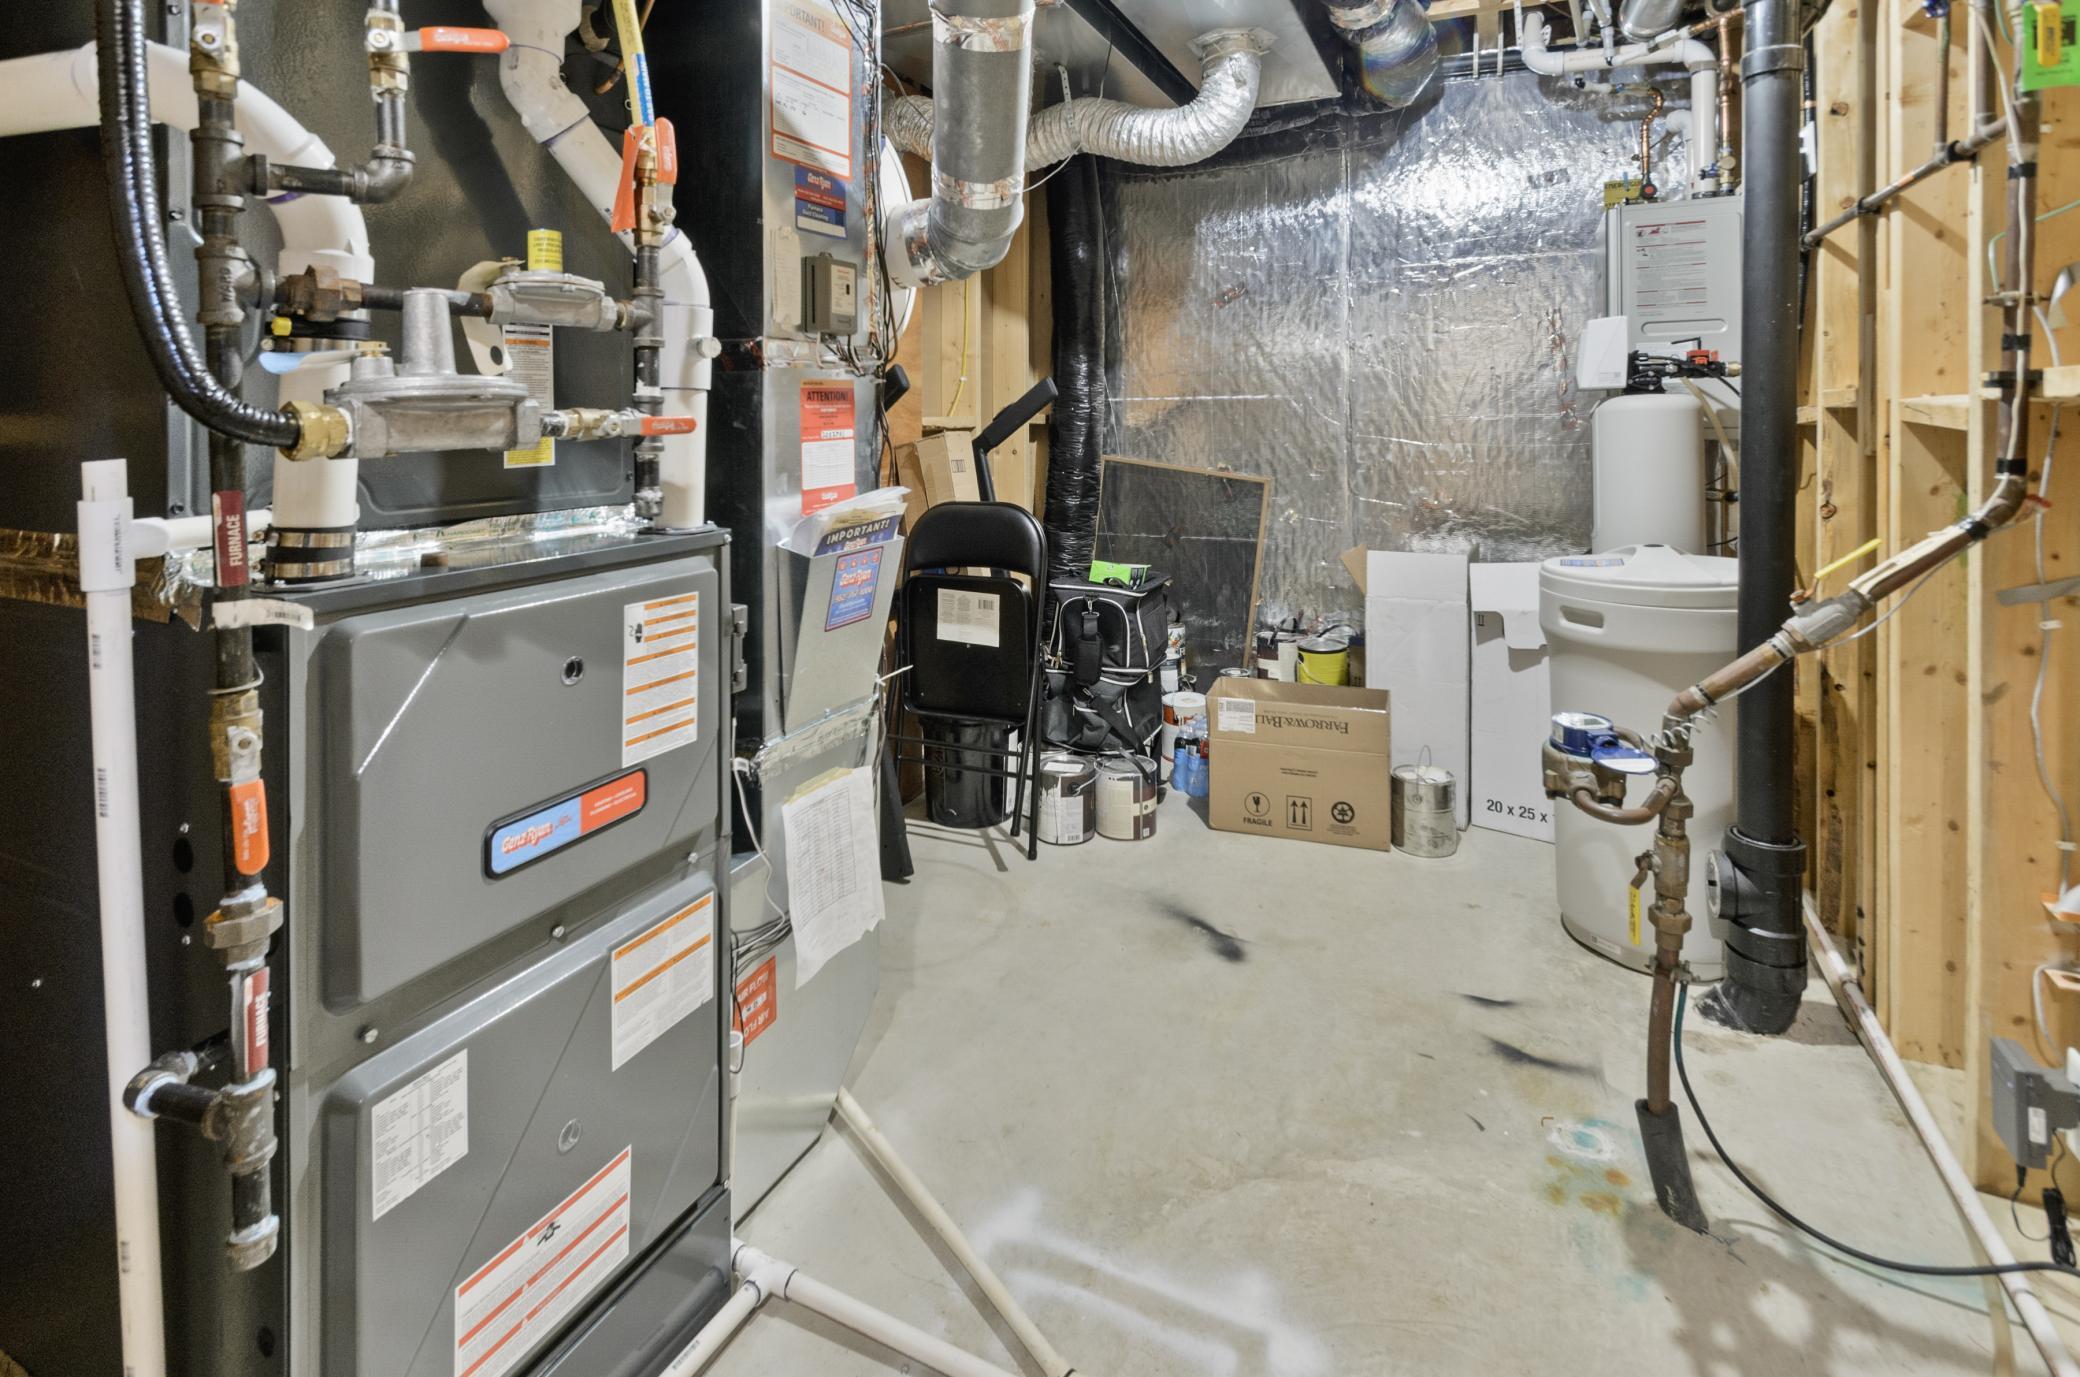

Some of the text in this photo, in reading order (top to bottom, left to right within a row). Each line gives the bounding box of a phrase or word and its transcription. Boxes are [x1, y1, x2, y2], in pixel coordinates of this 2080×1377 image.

[807, 391, 848, 401] ATTENTION!
[228, 513, 241, 568] FURNACE
[826, 519, 890, 545] IMPORTANT!
[1243, 817, 1273, 827] FRAGILE
[1486, 799, 1548, 823] 20 x 25 x
[255, 991, 272, 1047] FURNACE
[744, 1019, 757, 1037] FLO
